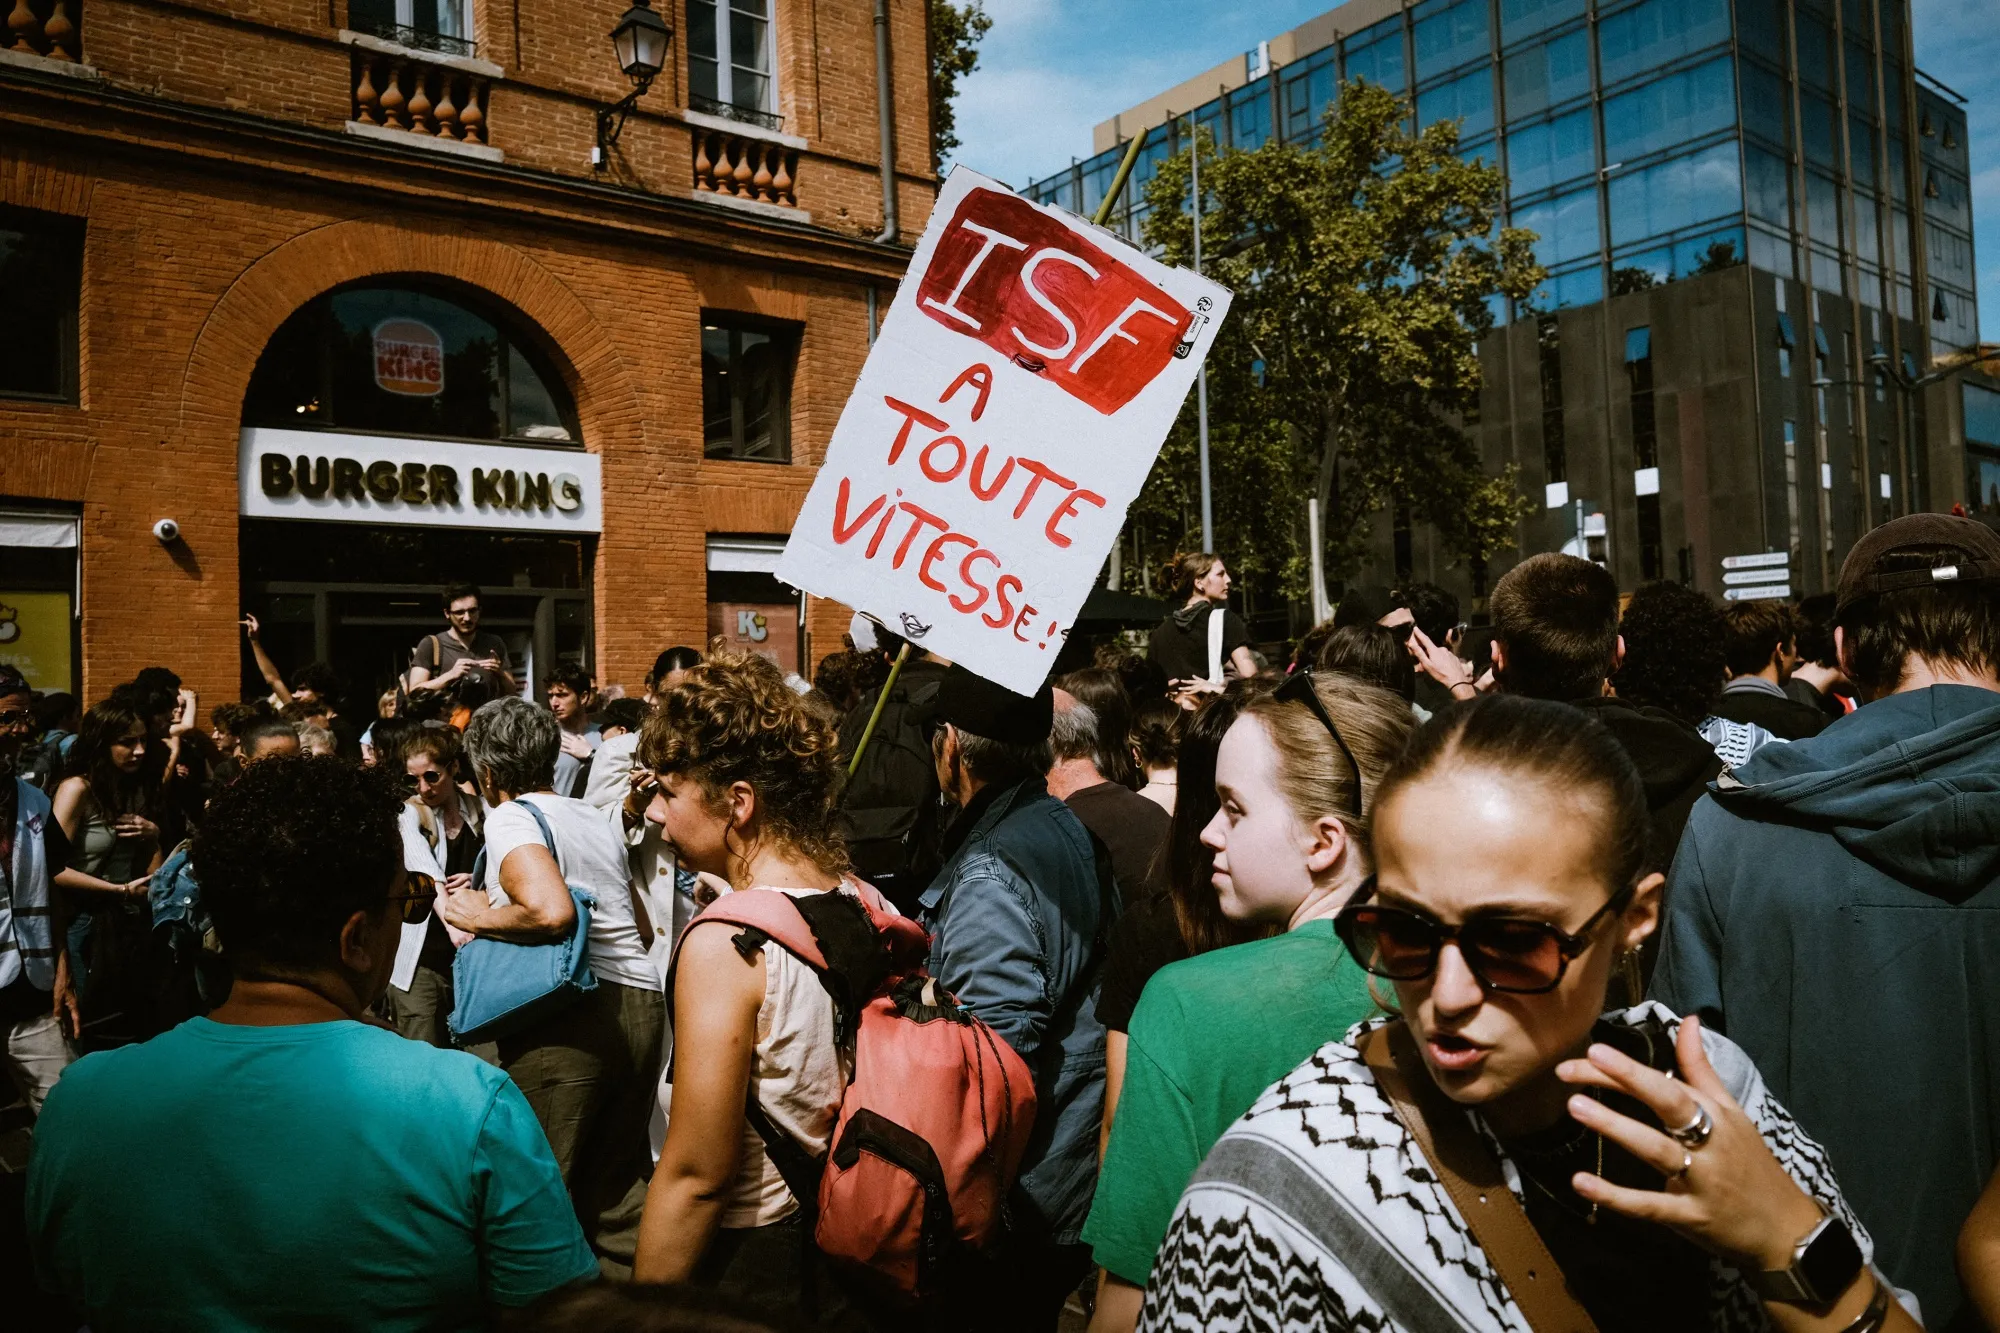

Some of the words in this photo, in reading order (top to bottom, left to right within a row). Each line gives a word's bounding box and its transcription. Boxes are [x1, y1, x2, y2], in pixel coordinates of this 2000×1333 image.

[922, 218, 1179, 374] ISF
[376, 341, 441, 361] BURGER
[377, 355, 442, 382] KING
[938, 362, 994, 423] A
[261, 452, 460, 505] BURGER
[472, 466, 582, 511] KING
[884, 395, 1107, 549] TOUTE
